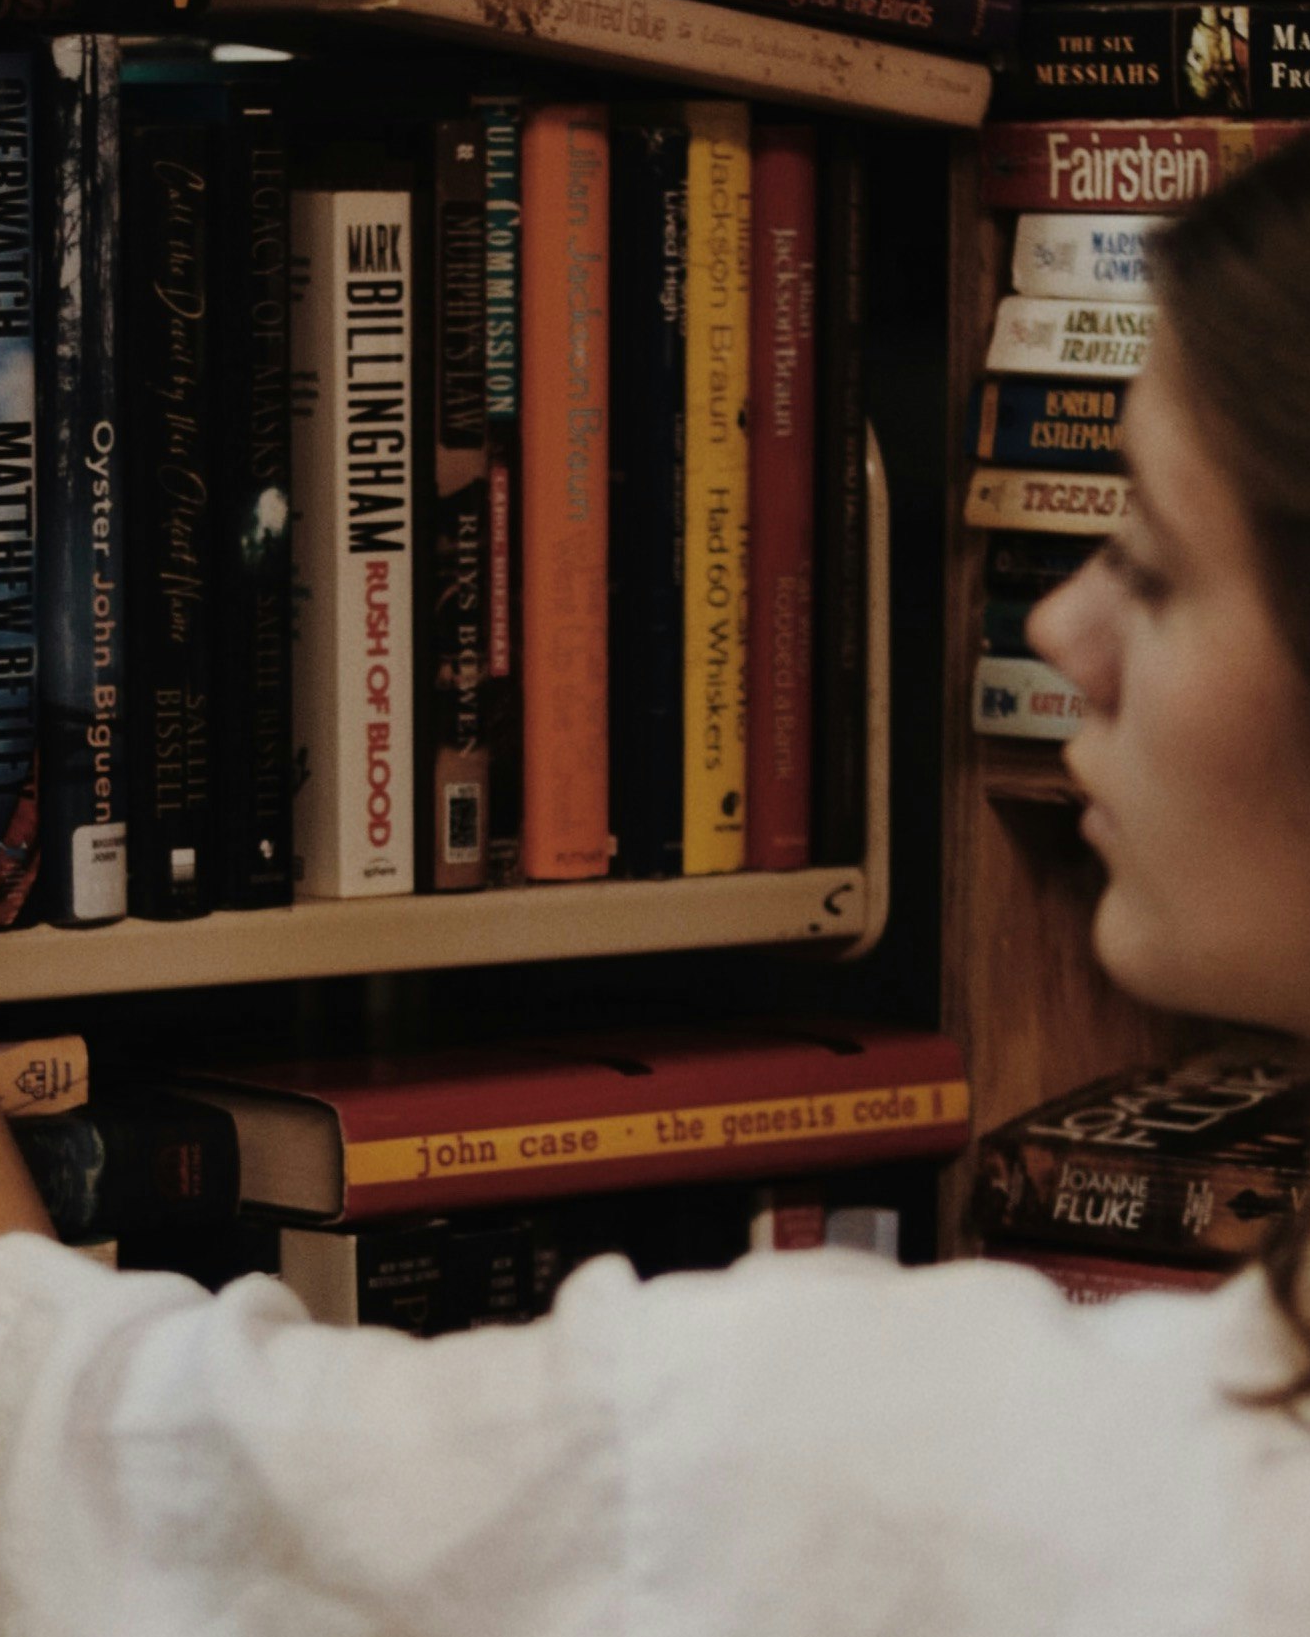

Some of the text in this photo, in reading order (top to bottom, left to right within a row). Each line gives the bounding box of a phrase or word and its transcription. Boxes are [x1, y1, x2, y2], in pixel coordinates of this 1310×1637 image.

[1034, 62, 1161, 87] MESSIAHS
[1058, 35, 1134, 55] THE SIX
[1046, 133, 1211, 205] Fairstein
[347, 223, 403, 274] MARK
[346, 279, 405, 554] BILLINGHAM
[365, 560, 391, 849] RUSH OF BLOOD
[417, 1087, 918, 1176] john case the genesis code
[1052, 1193, 1145, 1231] FLUKE
